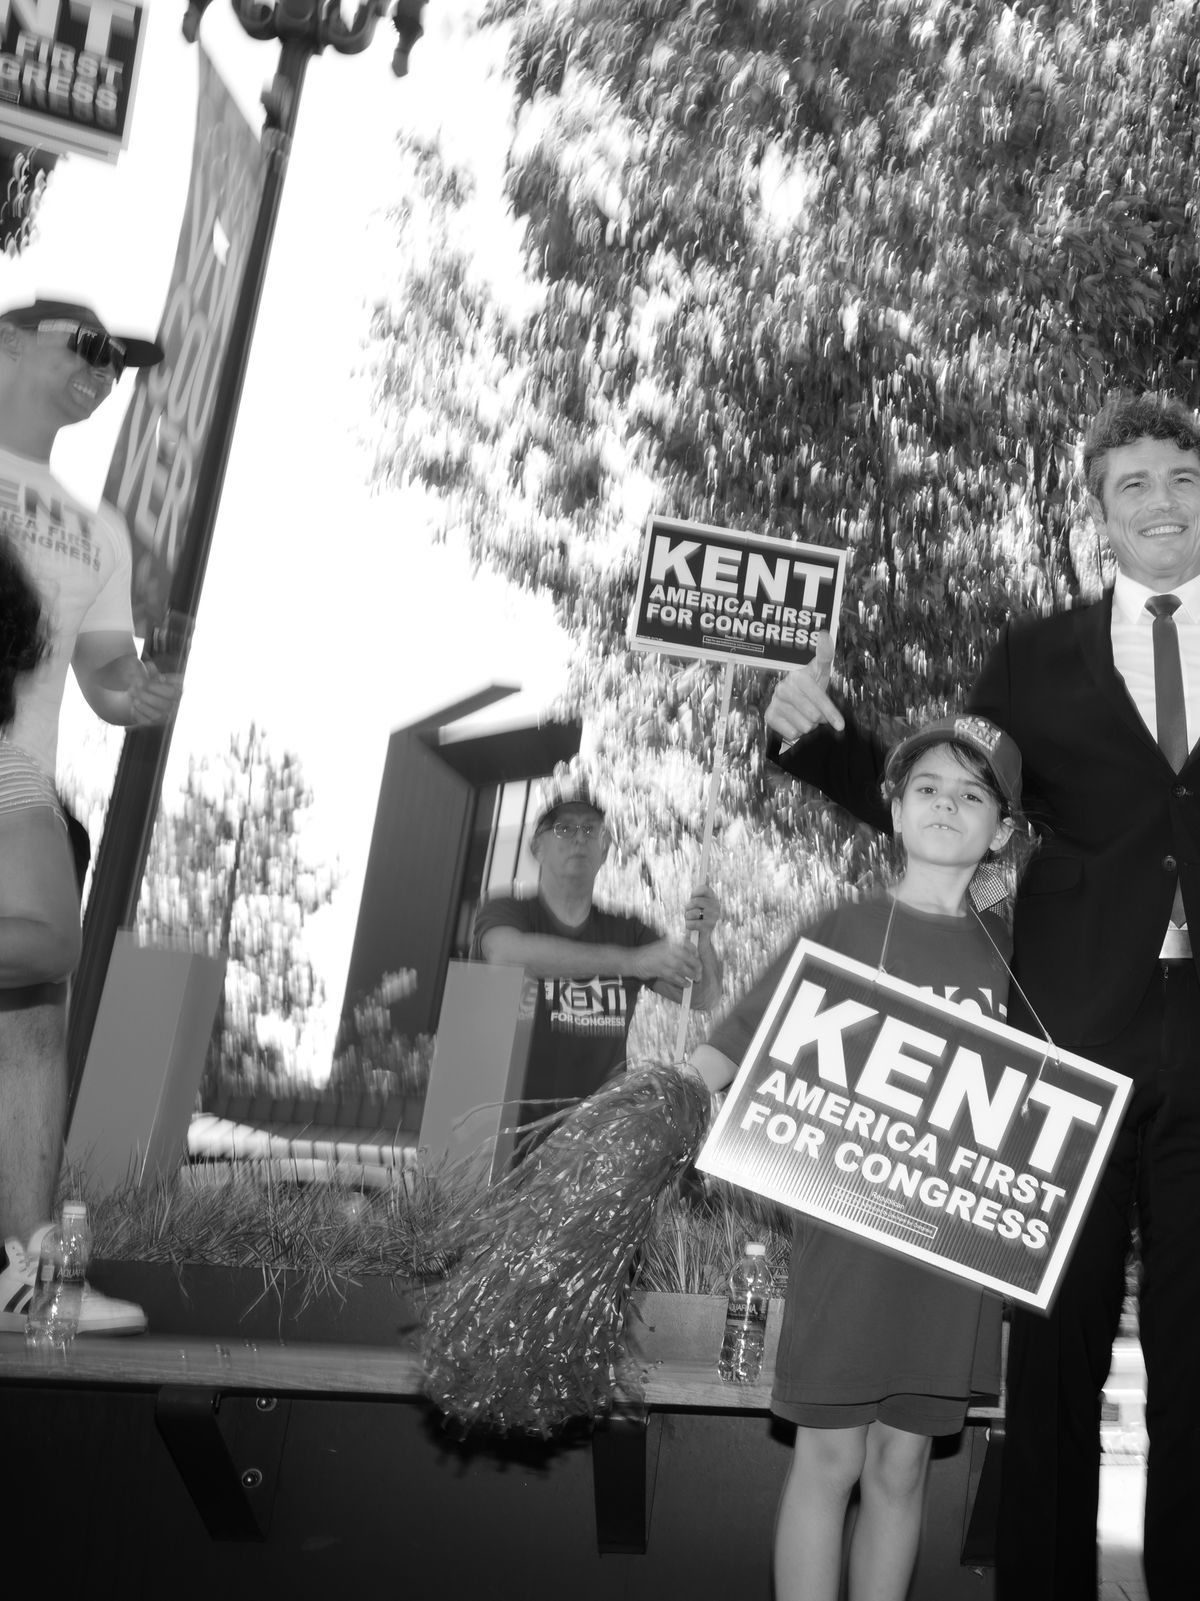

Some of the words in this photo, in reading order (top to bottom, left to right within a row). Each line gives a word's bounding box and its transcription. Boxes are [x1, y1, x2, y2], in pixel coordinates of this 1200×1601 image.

[15, 35, 123, 84] FIRST
[650, 535, 834, 608] KENT
[646, 602, 693, 625] FOR
[700, 612, 821, 647] CONGRESS
[649, 584, 754, 617] AMERICA
[761, 603, 826, 629] FIRST
[550, 1011, 574, 1023] FOR
[574, 1016, 626, 1027] CONGRESS
[769, 979, 1102, 1174] KENT
[756, 1069, 937, 1166] AMERICA
[949, 1145, 1066, 1213] FIRST
[740, 1101, 825, 1160] FOR
[834, 1142, 1049, 1249] CONGRESS
